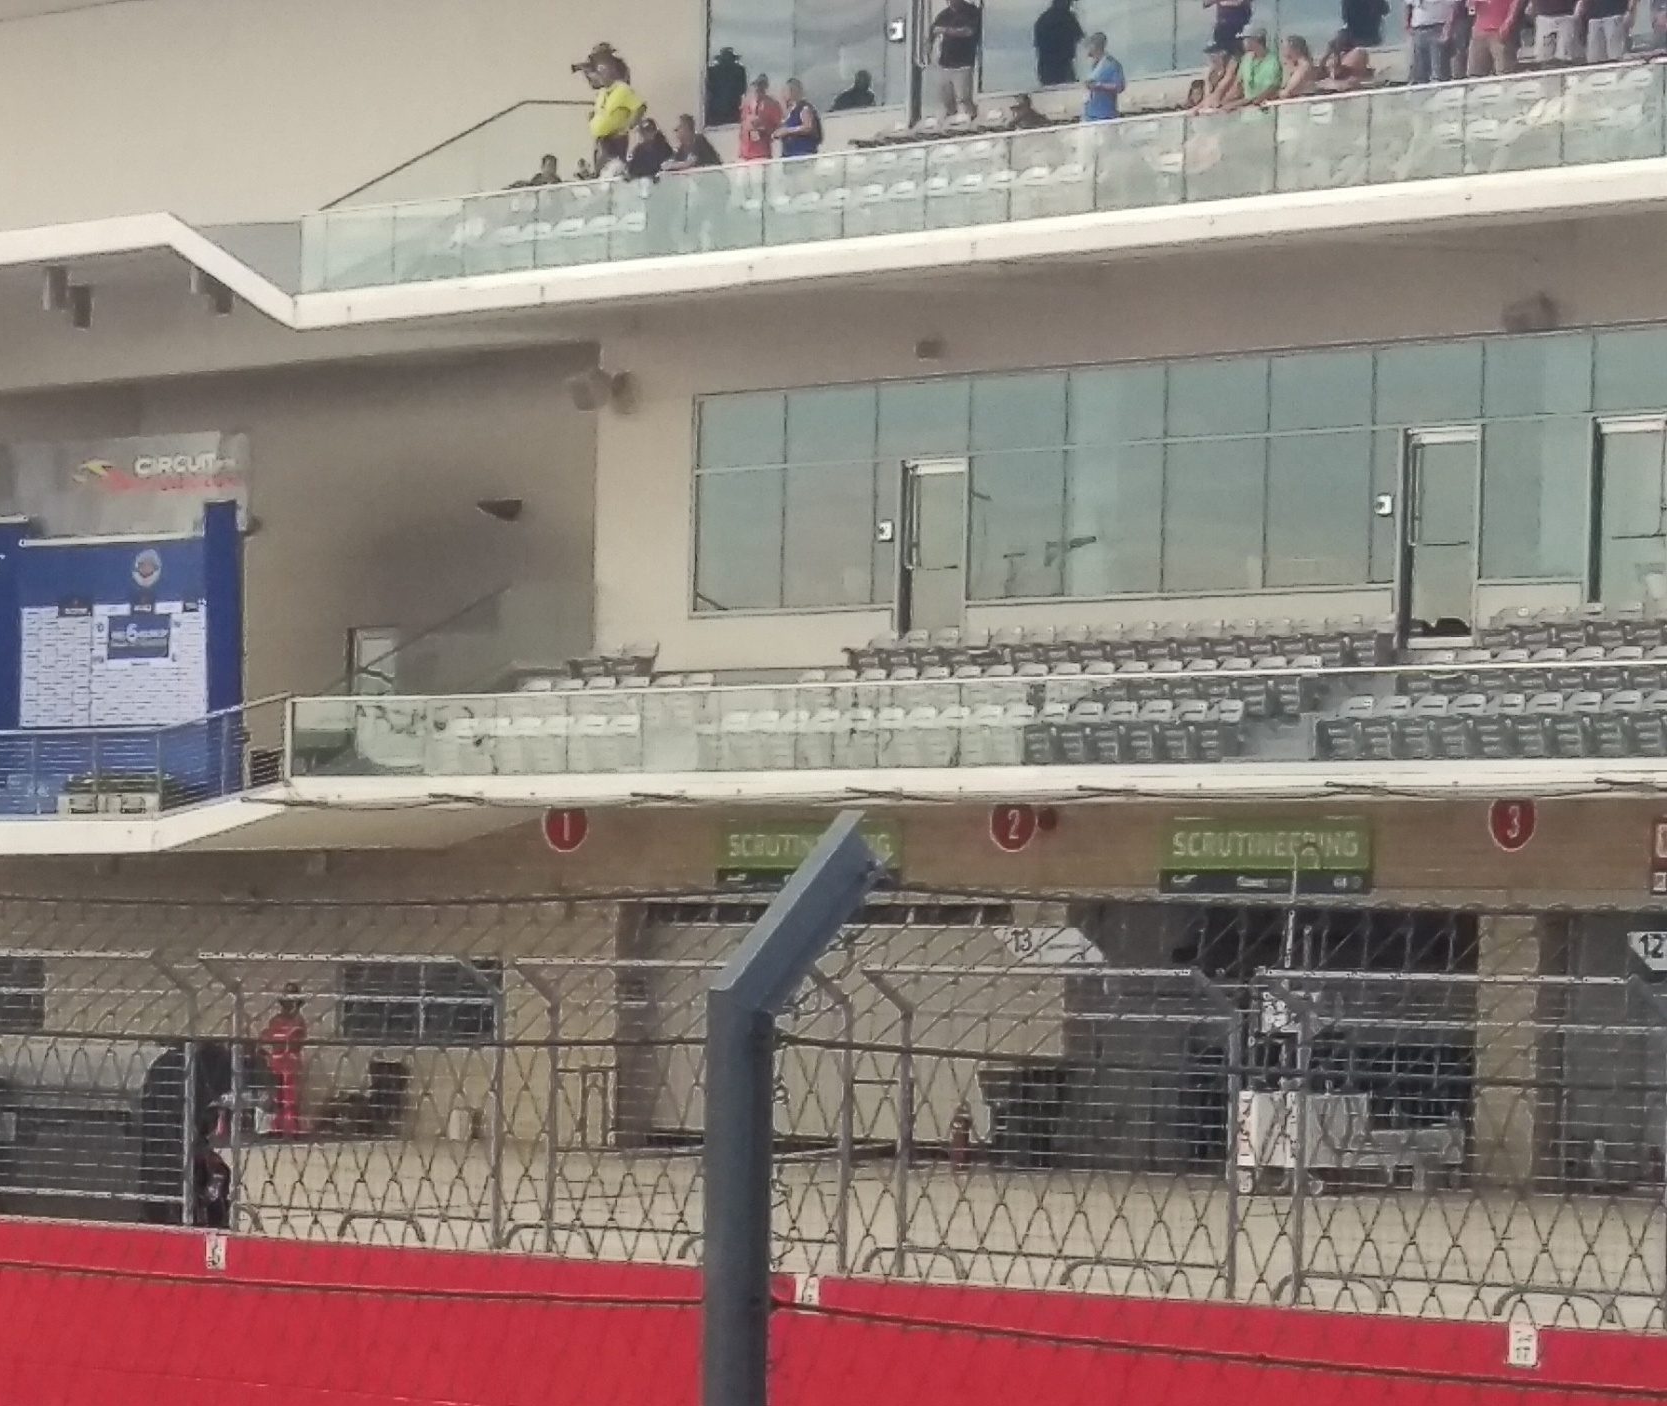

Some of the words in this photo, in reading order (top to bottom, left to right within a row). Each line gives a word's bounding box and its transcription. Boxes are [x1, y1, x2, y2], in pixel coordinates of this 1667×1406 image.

[1008, 809, 1019, 839] 2
[1507, 805, 1520, 839] 3
[1172, 831, 1358, 857] SCRUTINEERING
[1011, 929, 1033, 952] 13
[1638, 933, 1664, 959] 12
